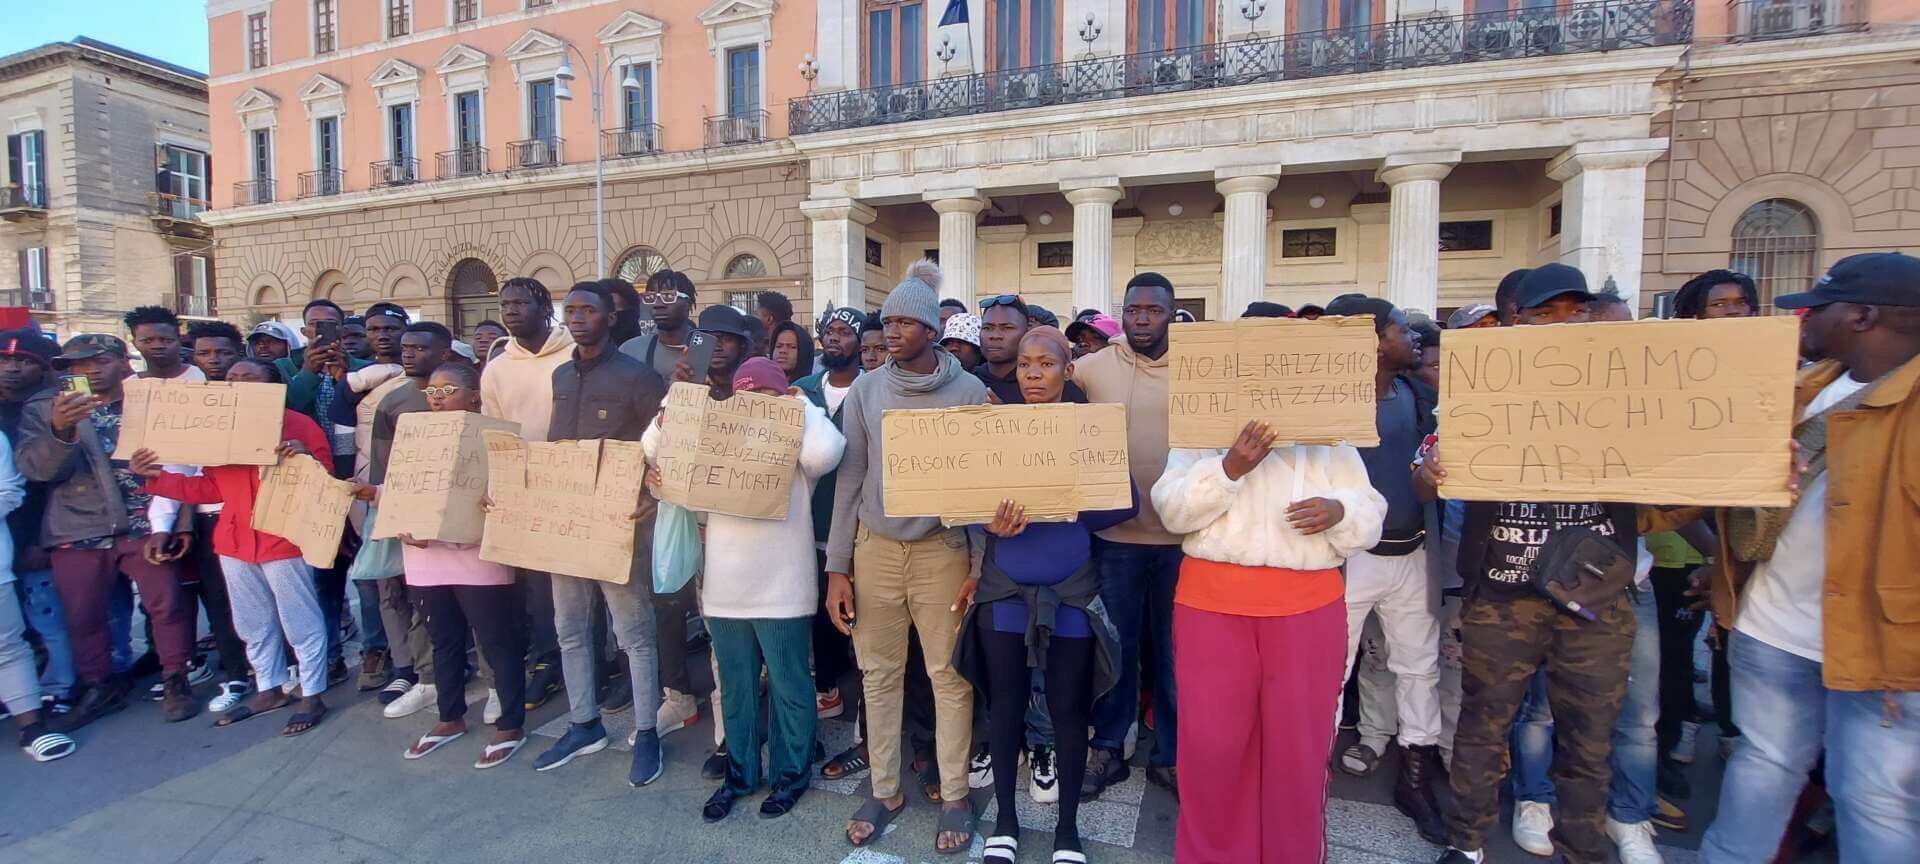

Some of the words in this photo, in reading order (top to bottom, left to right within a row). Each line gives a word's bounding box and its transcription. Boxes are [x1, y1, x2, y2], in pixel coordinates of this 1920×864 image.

[1178, 355, 1214, 381] NO
[1224, 352, 1255, 378] AL
[1264, 351, 1372, 378] RAZZISMO
[1170, 393, 1200, 416] NO
[1209, 391, 1238, 413] AL
[1251, 382, 1373, 410] RAZZISMO
[1079, 423, 1102, 438] 10
[1449, 394, 1664, 438] STANCHI
[1687, 396, 1733, 431] DI
[1022, 453, 1057, 468] UNA
[1069, 447, 1128, 467] STANZA
[1468, 443, 1632, 485] CARA
[727, 466, 781, 491] MORTI
